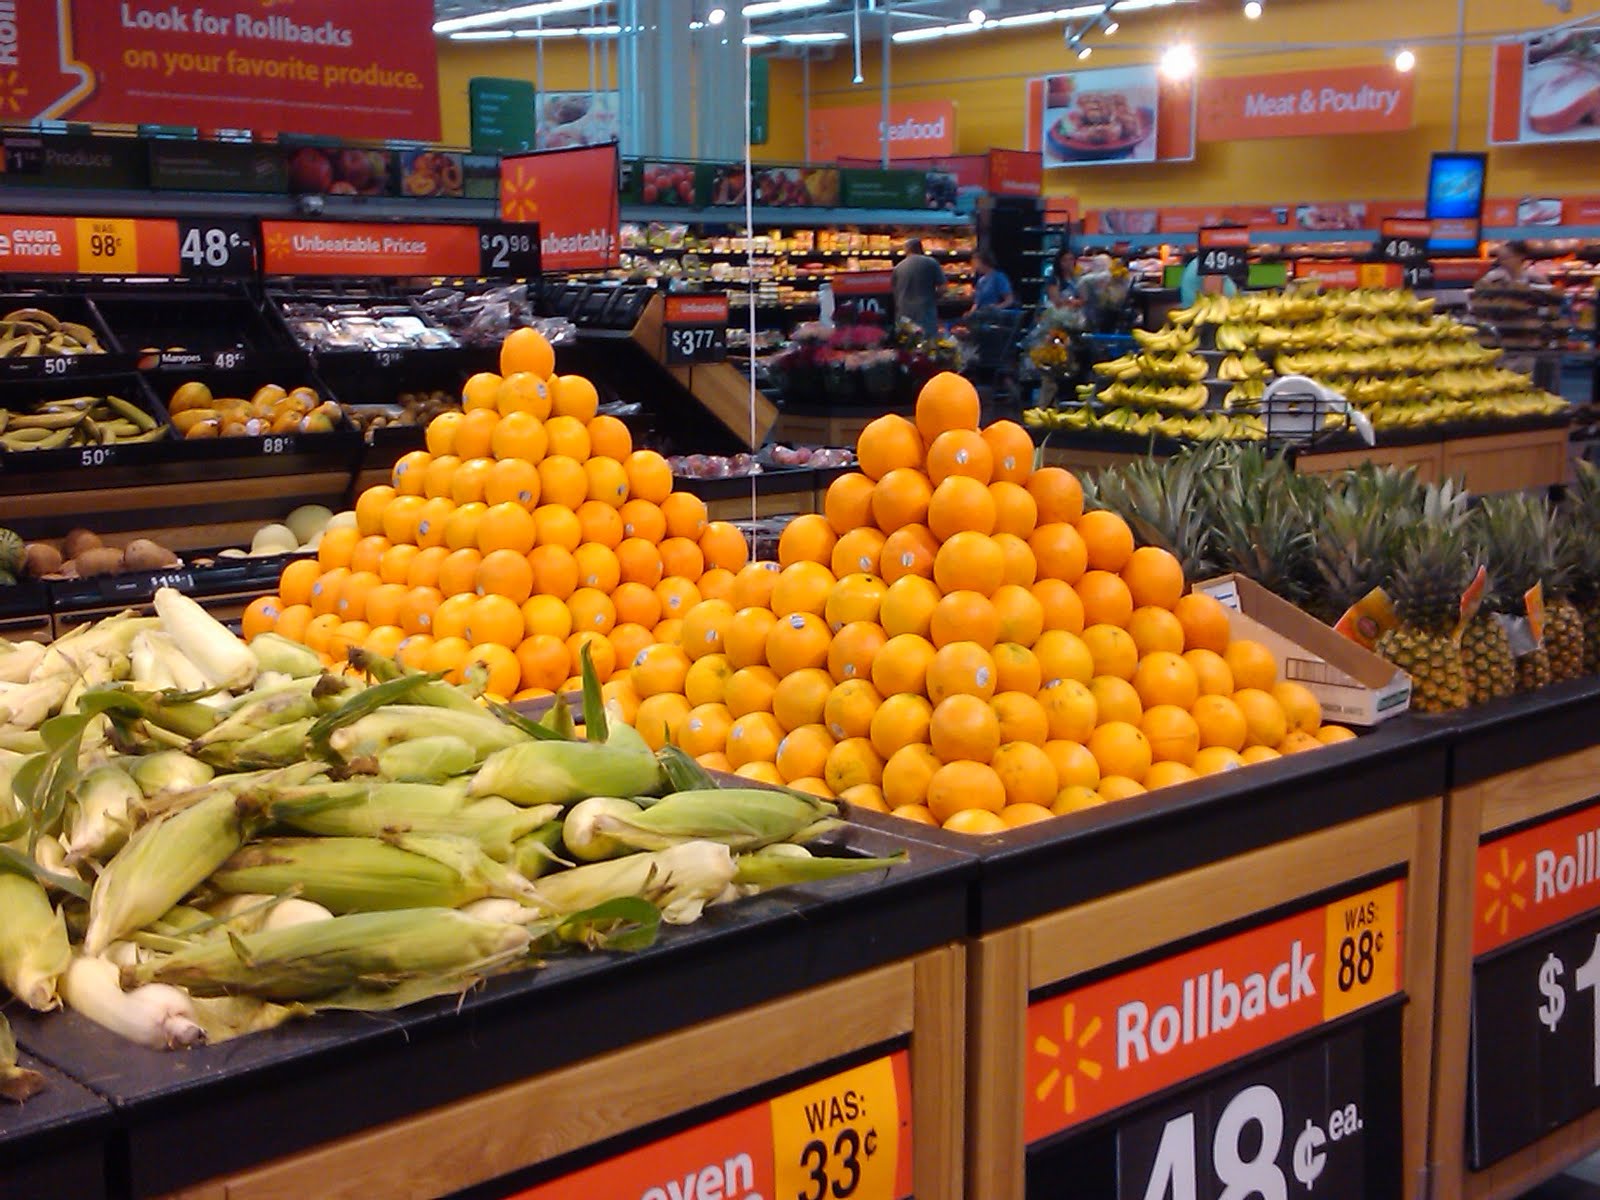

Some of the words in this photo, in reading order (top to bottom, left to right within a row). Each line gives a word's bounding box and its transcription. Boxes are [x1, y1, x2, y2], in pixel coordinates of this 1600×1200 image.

[122, 3, 188, 33] Look
[193, 9, 229, 36] for
[236, 16, 353, 47] Rollbacks
[123, 48, 157, 69] on
[163, 53, 221, 76] your
[227, 50, 317, 80] favorite
[324, 62, 424, 90] produce.
[1245, 92, 1295, 117] Meat
[1299, 88, 1316, 113] &
[1320, 84, 1400, 117] Poultry
[12, 229, 57, 242] even
[13, 242, 62, 256] more
[292, 235, 379, 253] Unbeatable
[382, 237, 427, 254] Prices
[541, 228, 615, 255] nbeatable
[162, 353, 202, 365] Mangoes
[1344, 901, 1380, 931] WAS:
[1115, 939, 1318, 1070] Rollback
[804, 1090, 866, 1135] WAS:
